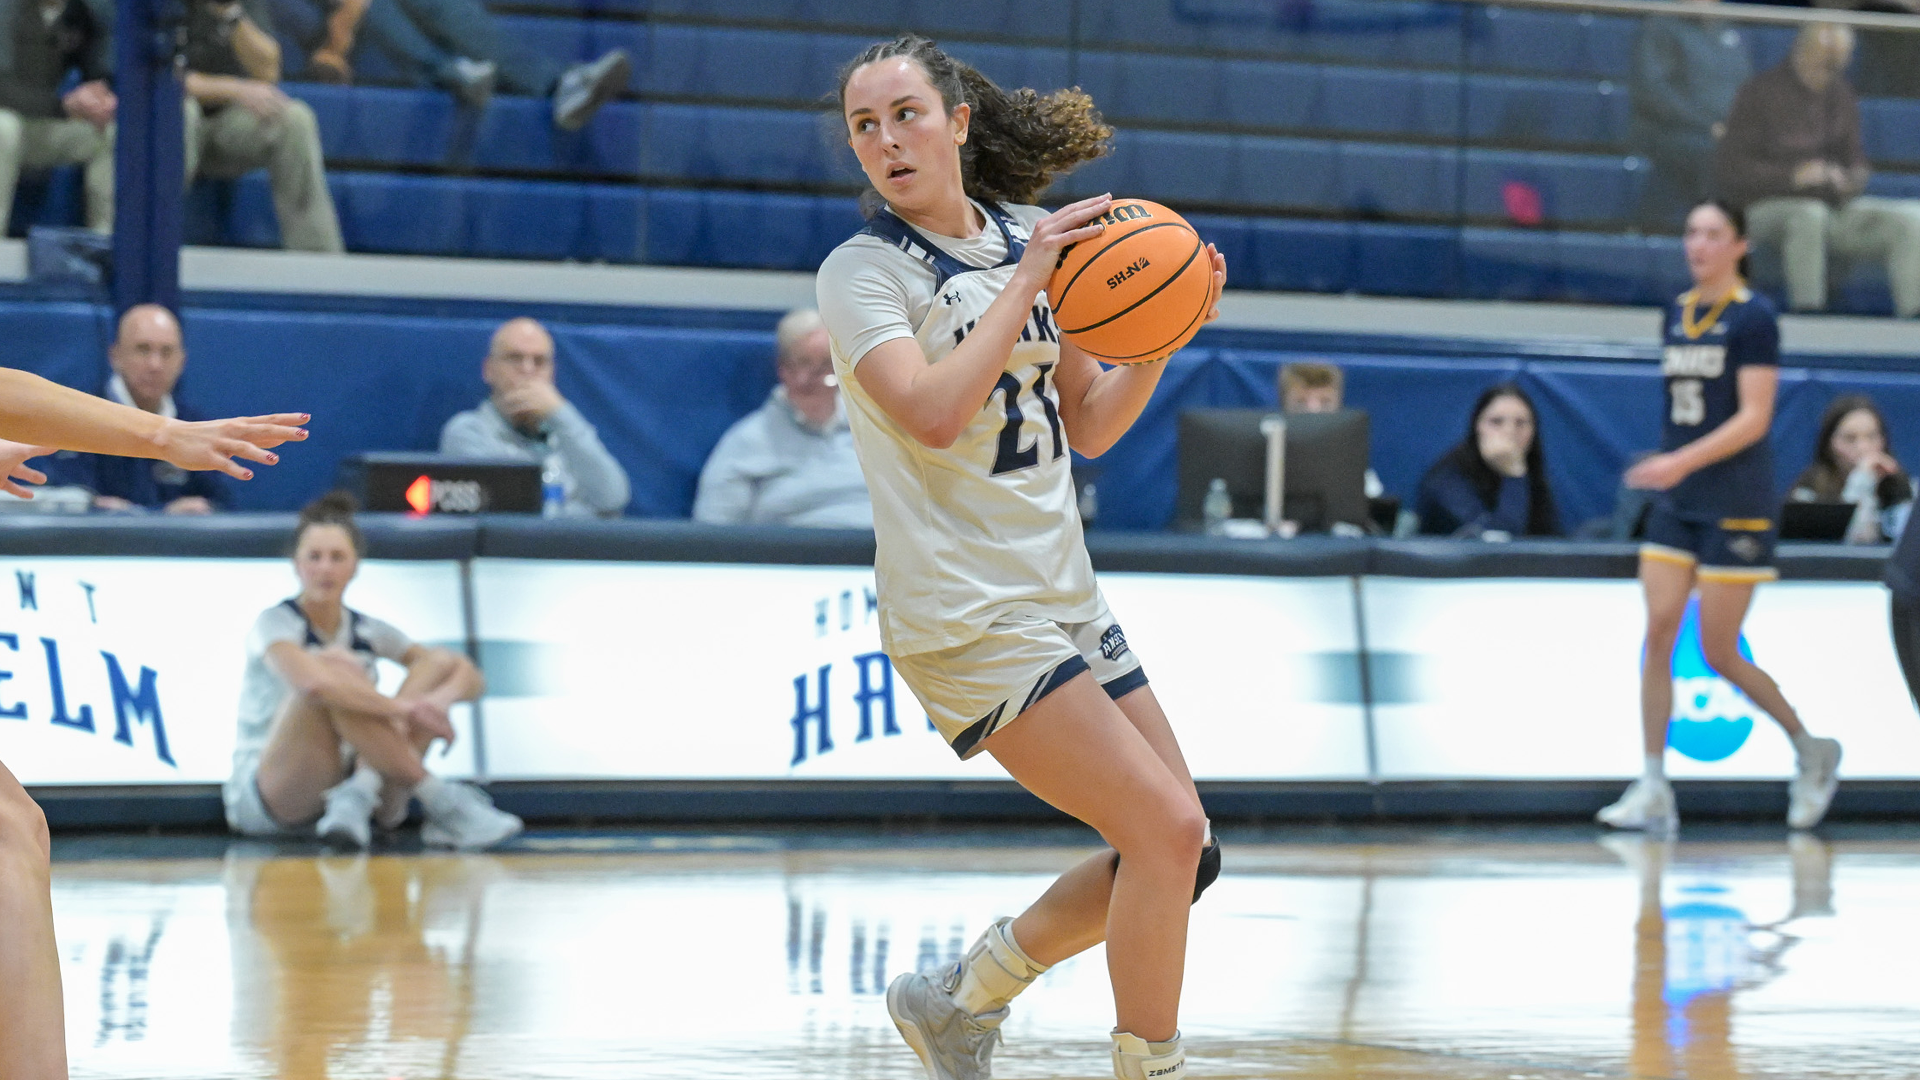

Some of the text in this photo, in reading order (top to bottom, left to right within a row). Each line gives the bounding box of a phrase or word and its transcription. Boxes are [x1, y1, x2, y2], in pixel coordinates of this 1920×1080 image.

[1106, 260, 1141, 290] NFHS
[981, 361, 1066, 477] 21
[790, 651, 937, 767] HA
